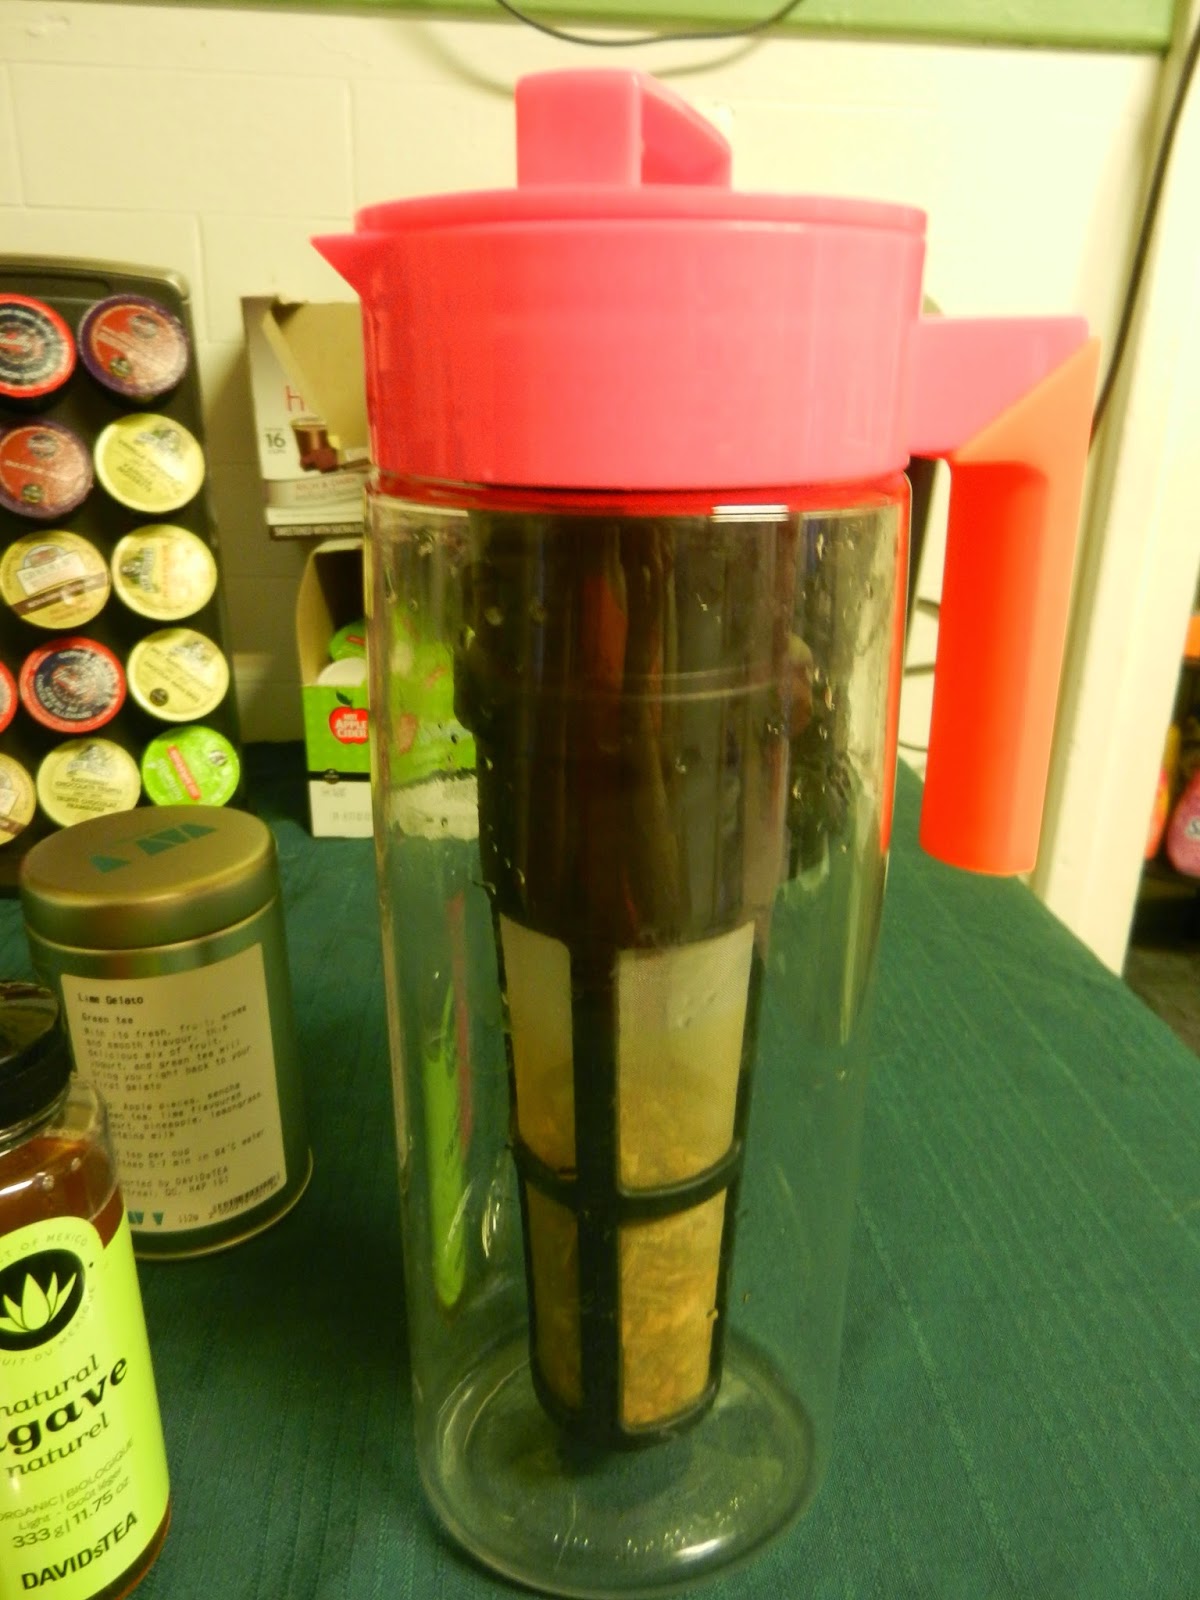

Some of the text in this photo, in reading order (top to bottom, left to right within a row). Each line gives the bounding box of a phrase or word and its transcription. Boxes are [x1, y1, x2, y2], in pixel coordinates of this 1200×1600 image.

[265, 431, 287, 449] 16
[335, 718, 367, 730] APPLE
[77, 992, 144, 1005] Lime Gelato
[81, 1012, 133, 1024] Green tea
[158, 1056, 190, 1070] green
[122, 1102, 153, 1112] Apple
[46, 1231, 89, 1248] MEXICO
[0, 1353, 100, 1417] natural
[0, 1357, 128, 1455] gave
[5, 1410, 110, 1479] naturel
[12, 1526, 52, 1549] 333
[54, 1524, 66, 1539] g
[72, 1488, 114, 1526] 11.75
[18, 1513, 51, 1531] Light
[21, 1509, 138, 1591] DAVIDsTEA
